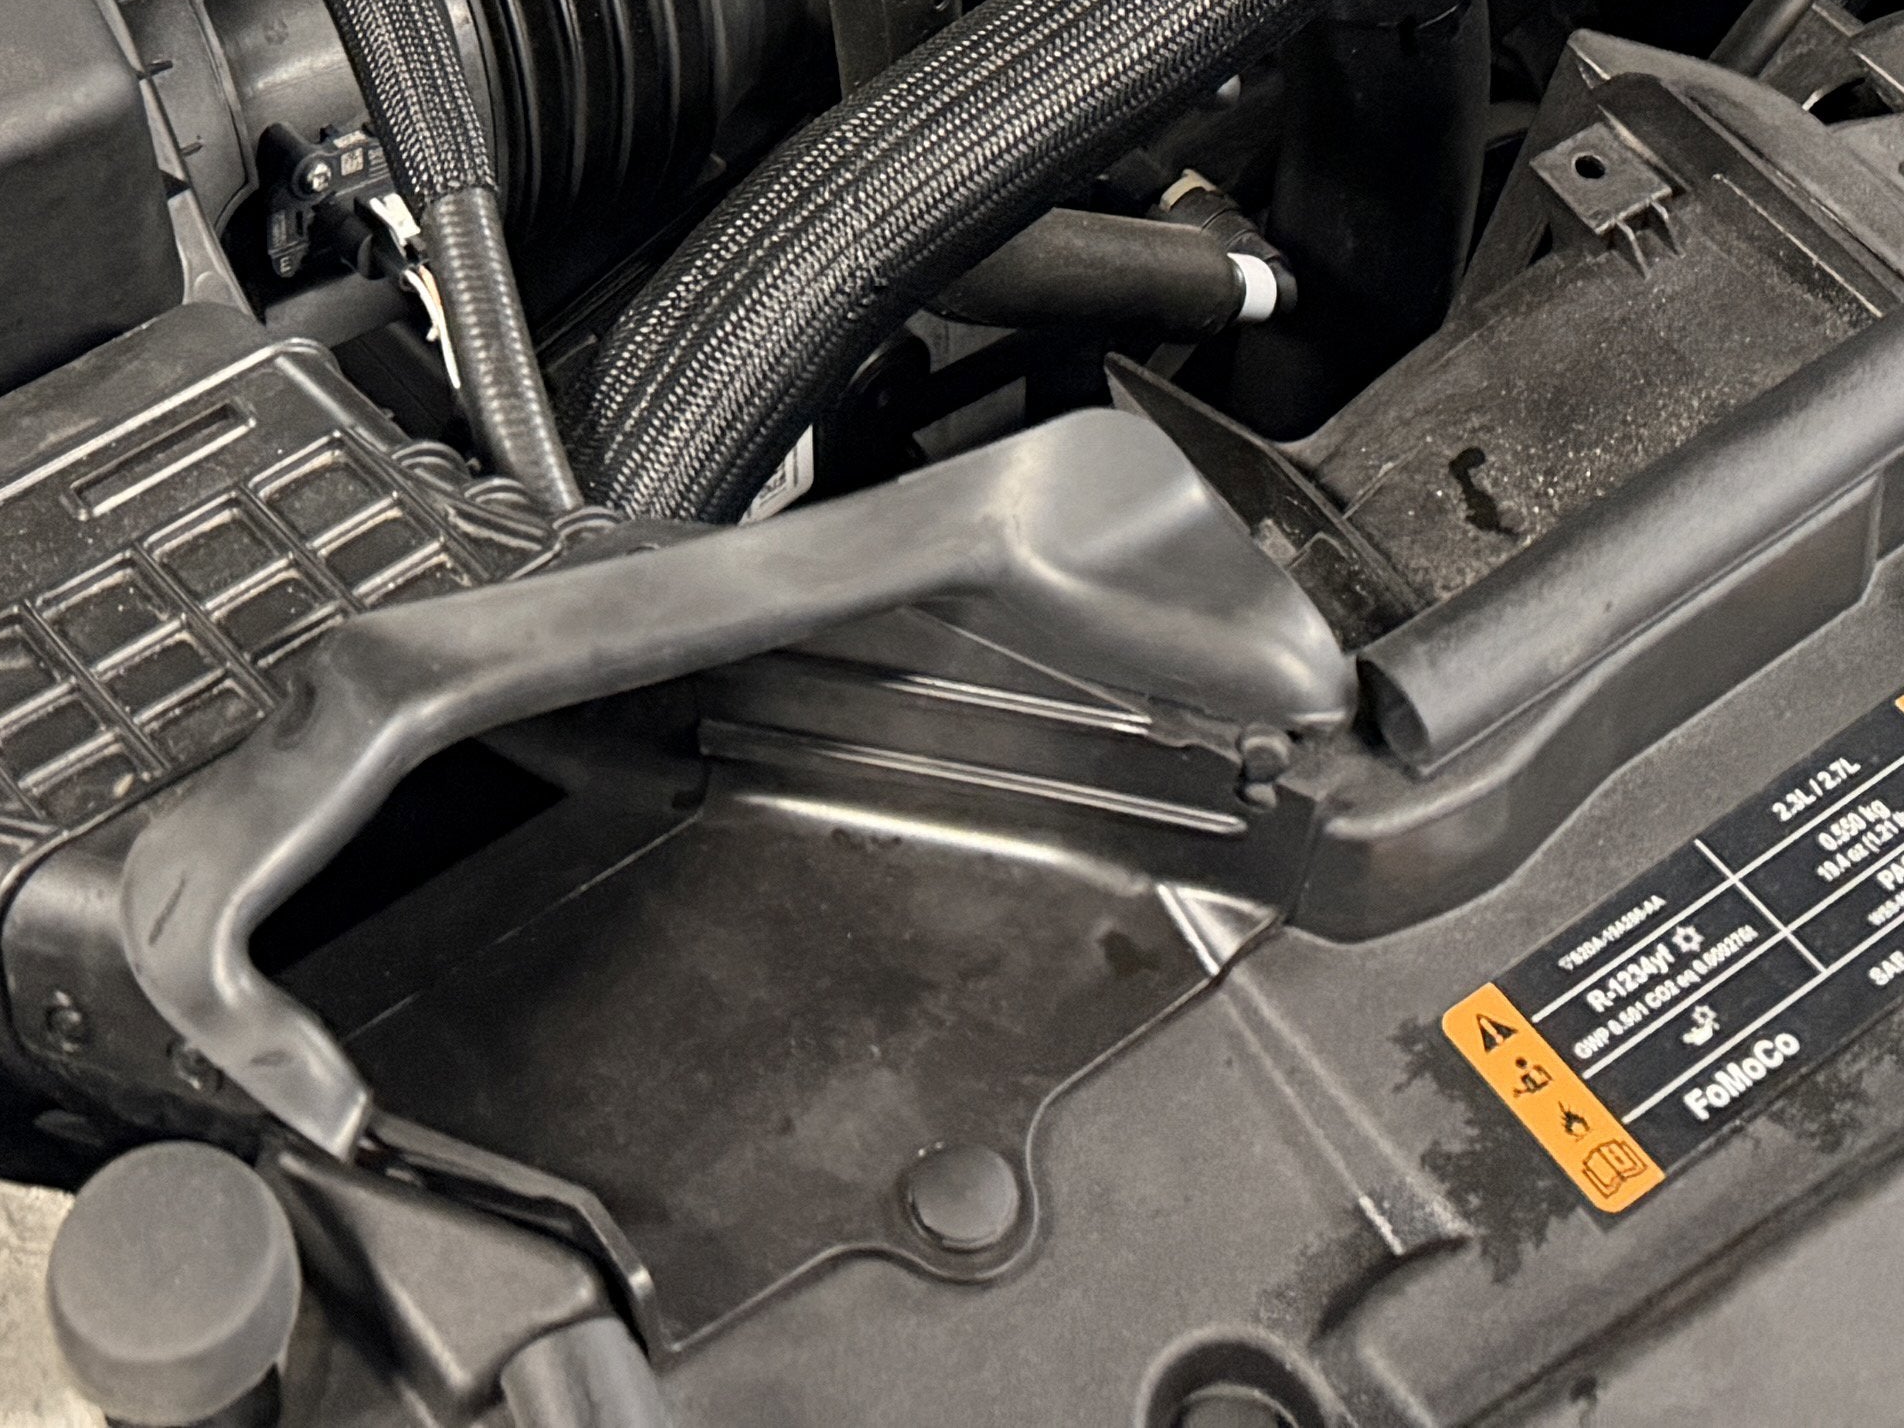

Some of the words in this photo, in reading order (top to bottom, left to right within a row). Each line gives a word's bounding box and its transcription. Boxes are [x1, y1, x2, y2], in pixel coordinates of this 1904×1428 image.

[1772, 789, 1816, 821] 2.3L
[1817, 758, 1861, 789] 2.7L
[1818, 812, 1866, 851] 0.550
[1858, 800, 1896, 829] kg
[1586, 943, 1675, 1012] R-1234yf
[1574, 1027, 1609, 1059] GWP
[1644, 980, 1680, 1009] CO2
[1683, 1033, 1800, 1120] FoMoCo
